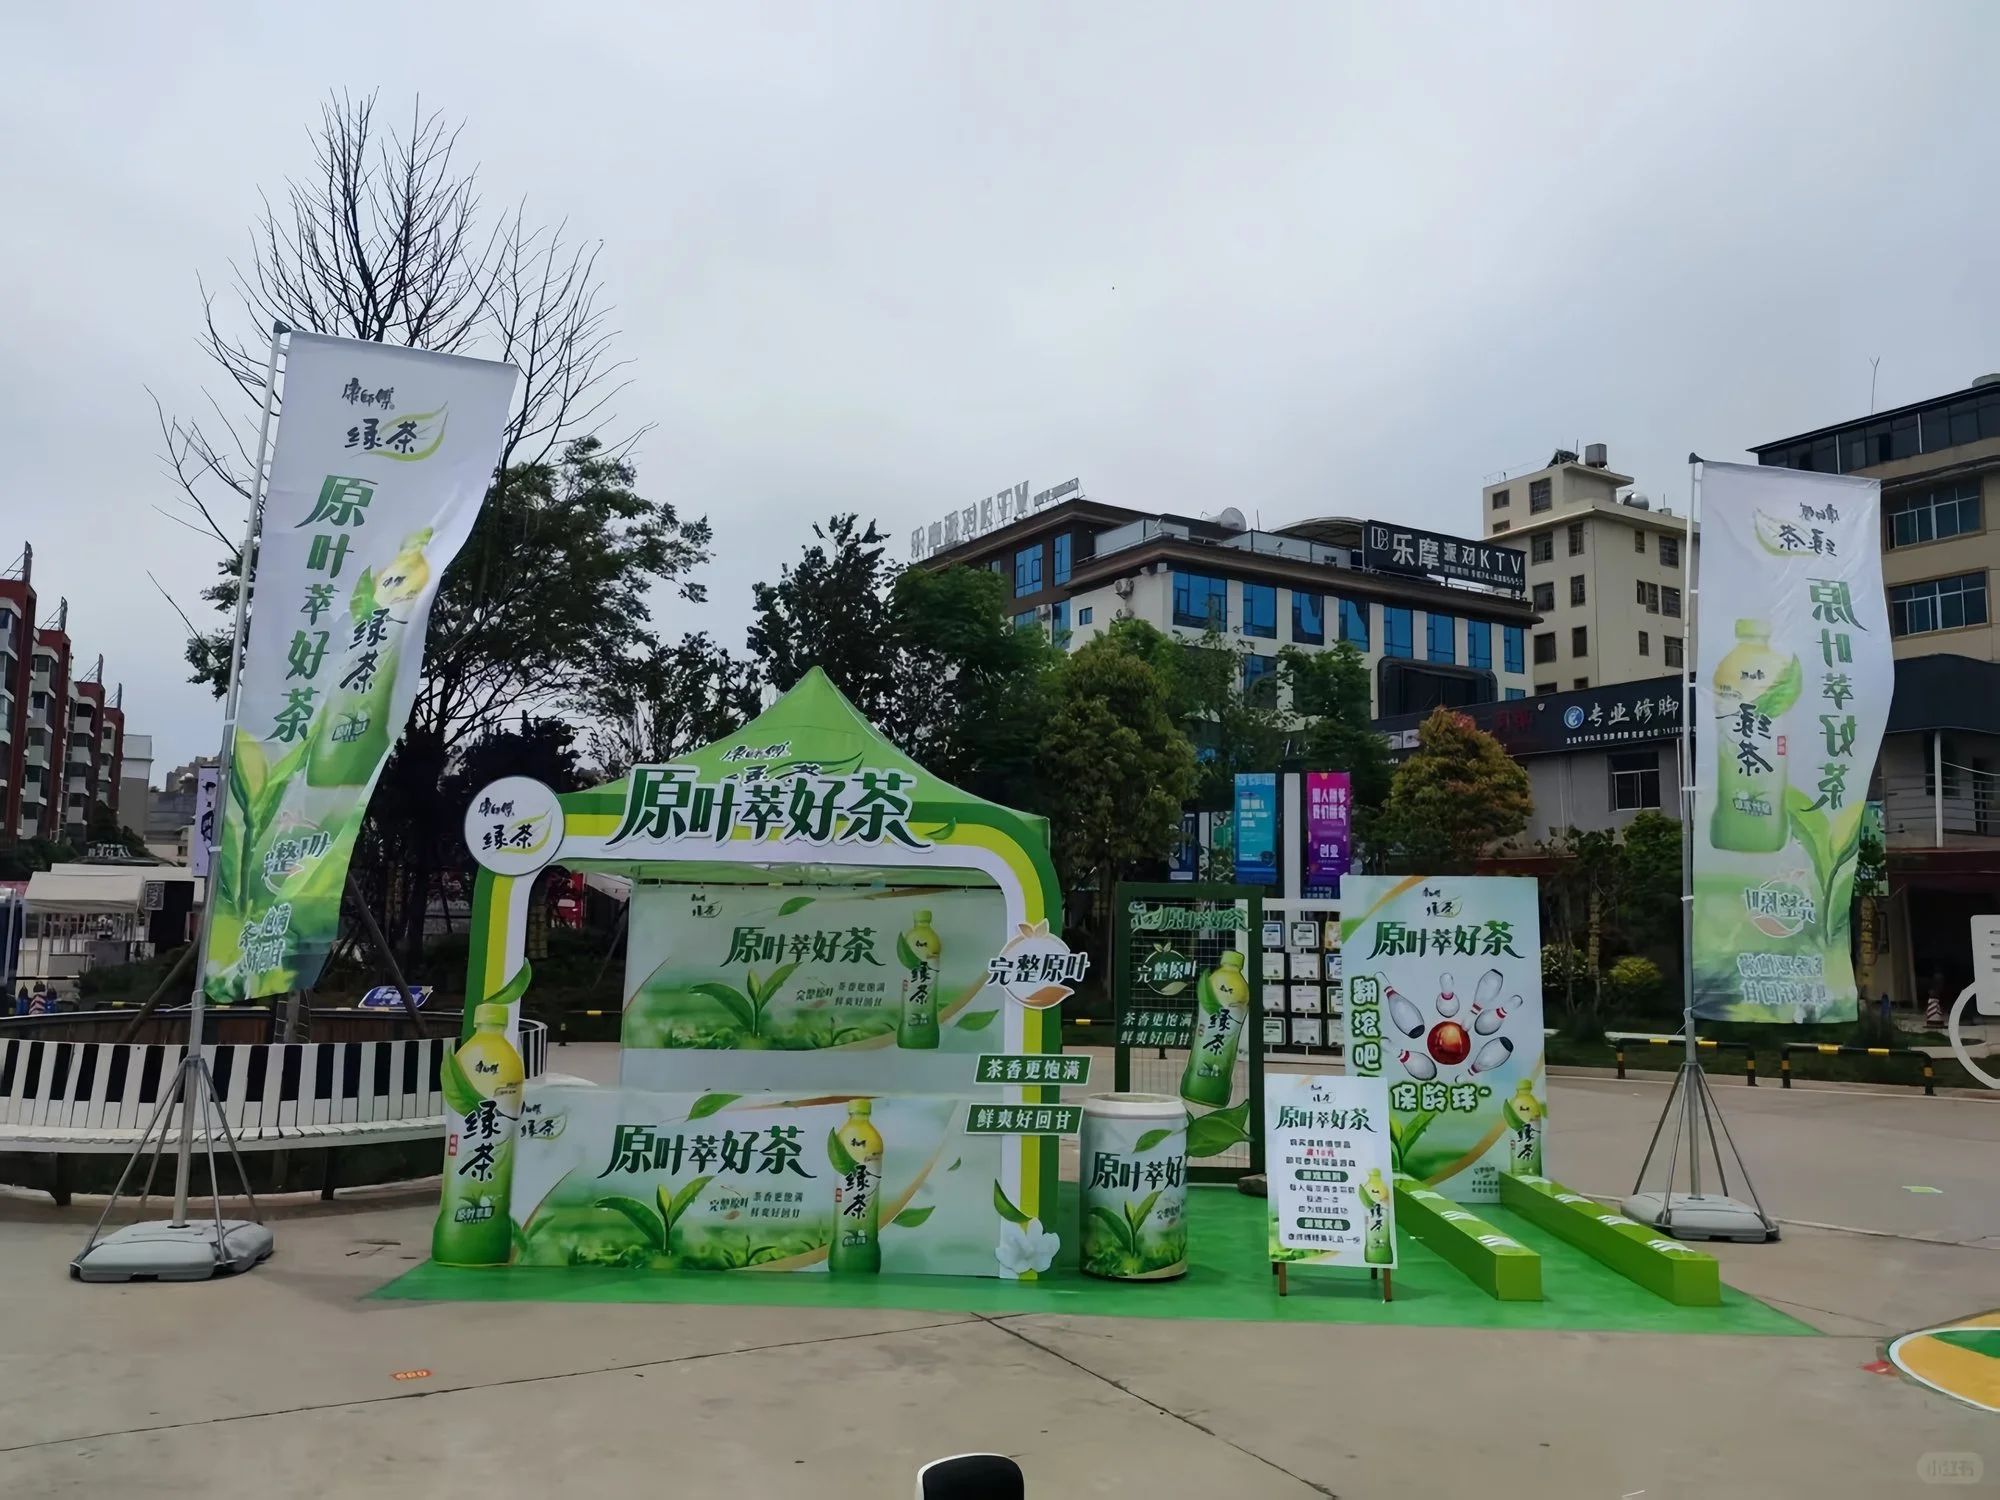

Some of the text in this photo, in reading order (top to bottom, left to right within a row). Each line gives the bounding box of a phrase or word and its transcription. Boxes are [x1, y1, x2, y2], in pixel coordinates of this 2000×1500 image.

[344, 418, 418, 454] 绿茶
[264, 474, 378, 744] 原叶萃好茶
[1588, 695, 1679, 727] 专业修脚
[606, 768, 932, 850] 原叶萃好茶
[482, 824, 533, 850] 绿茶
[720, 926, 886, 967] 原叶萃好茶
[1366, 920, 1526, 960] 原叶萃好茶
[990, 953, 1090, 985] 完整原叶
[1137, 960, 1198, 984] 完整原叶
[1123, 1012, 1192, 1027] 茶香更饱满
[1351, 975, 1381, 1077] 翻滚吧
[1120, 1031, 1189, 1045] 鲜爽好回甘
[987, 1059, 1080, 1079] 茶香更饱满
[977, 1108, 1071, 1129] 鲜爽好回甘
[458, 1100, 519, 1182] 绿茶
[597, 1124, 818, 1179] 原叶萃好茶
[1088, 1151, 1187, 1192] 原叶萃好
